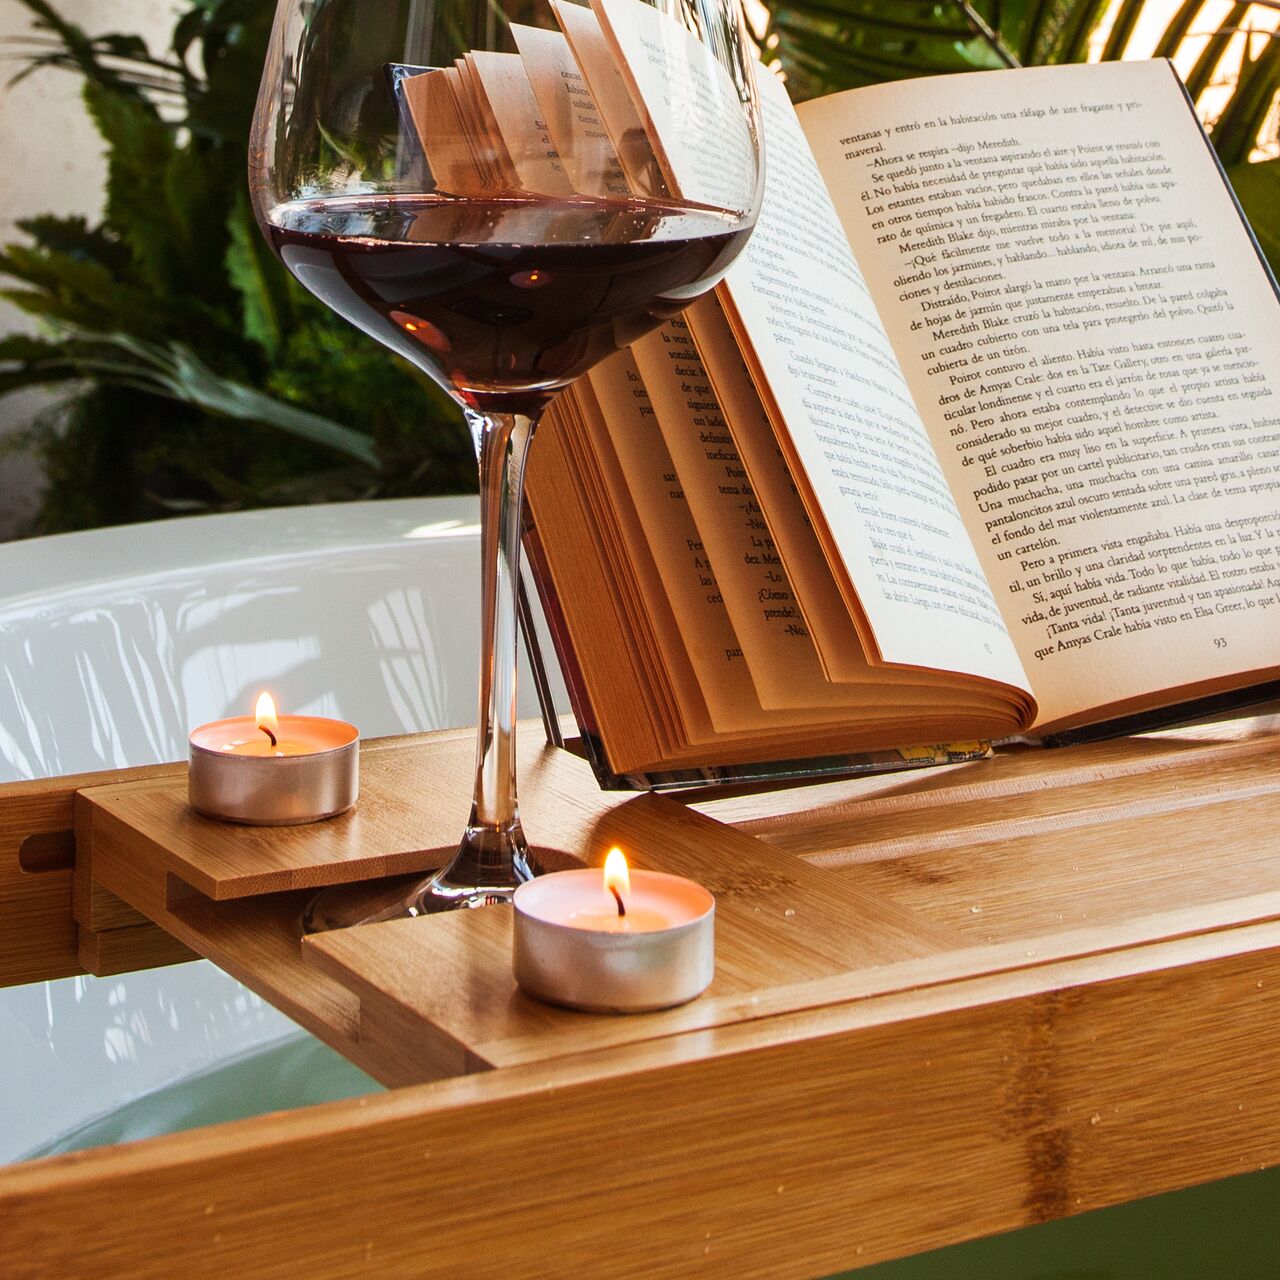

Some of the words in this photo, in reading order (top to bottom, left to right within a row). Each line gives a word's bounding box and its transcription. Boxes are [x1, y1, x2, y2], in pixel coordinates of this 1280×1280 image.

[839, 130, 882, 146] ventanas
[883, 127, 891, 138] y
[844, 141, 886, 160] maveral.
[870, 173, 884, 183] Se
[886, 165, 917, 182] quedó
[918, 162, 945, 176] junto
[905, 153, 916, 161] se
[860, 190, 873, 202] él.
[872, 186, 892, 198] No
[891, 180, 920, 193] había
[921, 171, 967, 188] necesidad
[864, 205, 885, 216] Los
[887, 195, 925, 210] estantes
[927, 188, 962, 201] estaban
[871, 220, 885, 230] en
[887, 213, 913, 225] otros
[914, 205, 954, 219] tiempos
[876, 232, 897, 244] rato
[899, 227, 912, 238] de
[915, 220, 954, 236] química
[898, 235, 946, 254] Meredith
[946, 230, 975, 243] Blake
[941, 244, 991, 259] fácilmente
[892, 270, 932, 287] oliendo
[932, 266, 949, 277] los
[950, 259, 996, 276] jazmines,
[898, 287, 931, 302] ciones
[932, 285, 940, 295] y
[943, 272, 1006, 290] destilaciones.
[920, 293, 970, 312] Distraído,
[970, 287, 1002, 300] Poirot
[1003, 281, 1032, 294] alargó
[909, 319, 923, 331] de
[923, 313, 952, 327] hojas
[954, 308, 967, 319] de
[968, 301, 1003, 319] jazmín
[1004, 300, 1023, 312] que
[931, 321, 980, 341] Meredith
[981, 316, 1010, 329] Blake
[1012, 310, 1040, 323] cruzó
[920, 351, 936, 361] un
[938, 340, 973, 356] cuadro
[976, 331, 1018, 346] cubierto
[1021, 328, 1040, 338] con
[926, 358, 969, 376] cubierta
[971, 352, 984, 364] de
[986, 351, 1001, 360] un
[1002, 344, 1030, 357] tirón.
[948, 371, 982, 386] Poirot
[984, 362, 1026, 377] contuvo
[1028, 356, 1038, 368] el
[938, 393, 961, 406] dros
[963, 387, 976, 399] de
[979, 381, 1012, 395] Amyas
[1014, 372, 1045, 386] Crale:
[1046, 369, 1064, 380] dos
[943, 404, 976, 421] ticular
[977, 392, 1033, 411] londinense
[1034, 390, 1041, 401] y
[1044, 385, 1054, 397] el
[1055, 383, 1086, 394] cuarto
[949, 423, 968, 436] nó.
[969, 418, 995, 430] Pero
[999, 410, 1028, 423] ahora
[1031, 401, 1061, 415] estaba
[955, 427, 1017, 452] considerado
[1019, 425, 1031, 434] su
[1033, 418, 1063, 431] mejor
[961, 455, 975, 467] de
[977, 447, 997, 465] qué
[999, 438, 1043, 456] soberbio
[1044, 431, 1073, 445] había
[1074, 427, 1095, 440] sido
[983, 464, 997, 477] El
[1000, 457, 1036, 473] cuadro
[1039, 453, 1055, 463] era
[1058, 448, 1080, 459] muy
[972, 479, 1011, 501] podido
[1012, 473, 1038, 490] pasar
[1040, 469, 1058, 483] por
[1060, 466, 1076, 475] un
[1077, 457, 1104, 472] cartel
[977, 500, 1003, 513] Una
[1007, 484, 1063, 505] muchacha,
[1064, 480, 1085, 491] una
[1088, 469, 1137, 486] muchacha
[984, 504, 1054, 533] pantaloncitos
[1054, 495, 1076, 510] azul
[1077, 492, 1110, 505] oscuro
[991, 532, 1002, 545] el
[1003, 524, 1035, 541] fondo
[1038, 518, 1055, 531] del
[1056, 515, 1077, 527] mar
[1078, 501, 1148, 521] violentamente
[996, 550, 1013, 561] un
[1014, 536, 1061, 556] cartelón.
[1019, 558, 1046, 572] Pero
[1048, 556, 1055, 564] a
[1057, 545, 1099, 565] primera
[1100, 539, 1124, 551] vista
[1125, 528, 1172, 547] engañaba.
[1008, 579, 1025, 593] til,
[1025, 577, 1041, 588] un
[1041, 567, 1073, 583] brillo
[1074, 566, 1081, 577] y
[1084, 561, 1105, 572] una
[1106, 549, 1146, 567] claridad
[1147, 540, 1213, 559] sorprendentes
[1020, 610, 1048, 625] vida,
[1048, 605, 1062, 617] de
[1062, 591, 1112, 617] juventud,
[1112, 589, 1125, 601] de
[1126, 583, 1165, 597] radiante
[1166, 571, 1209, 588] vitalidad.
[1032, 590, 1048, 604] Sí,
[1049, 583, 1072, 600] aquí
[1073, 577, 1103, 592] había
[1104, 571, 1129, 584] vida.
[1127, 565, 1155, 579] Todo
[1155, 563, 1168, 574] lo
[1045, 620, 1080, 639] ¡Tanta
[1080, 610, 1107, 625] vida!
[1109, 605, 1141, 622] ¡Tanta
[1142, 592, 1187, 615] juventud
[1187, 593, 1194, 605] y
[1034, 645, 1055, 661] que
[1057, 634, 1092, 652] Amyas
[1093, 625, 1123, 640] Crale
[1122, 618, 1152, 633] había
[1153, 615, 1178, 626] visto
[1179, 611, 1193, 621] en
[1192, 606, 1214, 618] Elsa
[1213, 636, 1228, 649] 93
